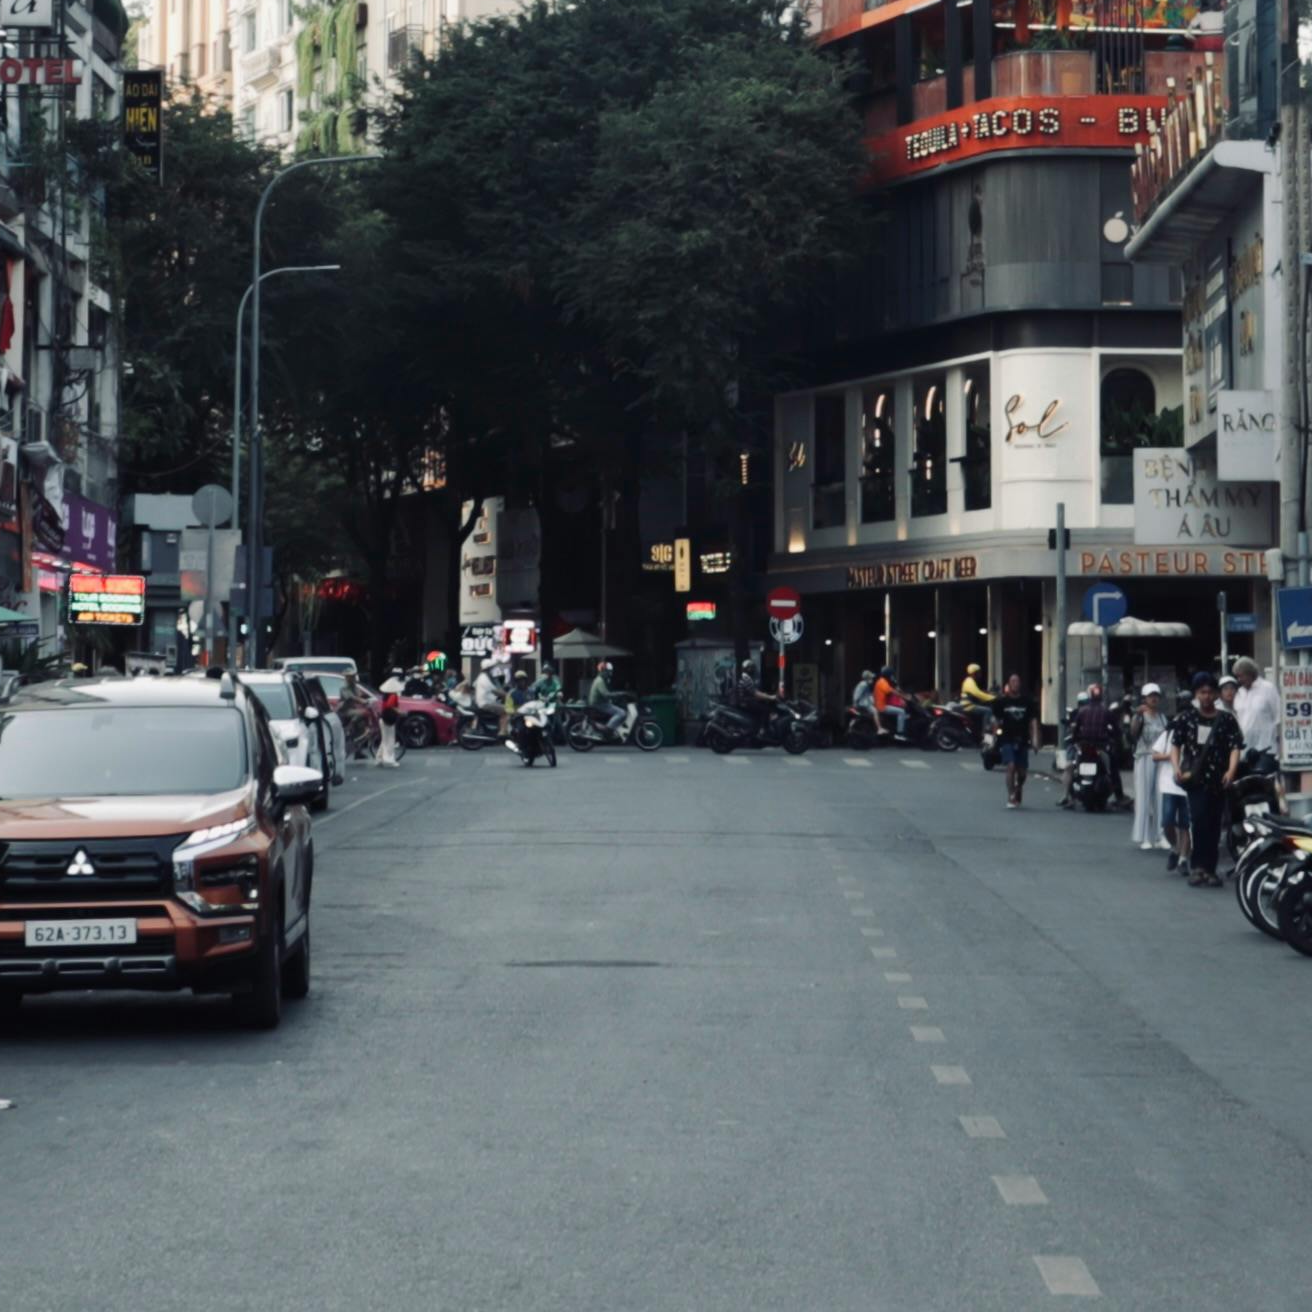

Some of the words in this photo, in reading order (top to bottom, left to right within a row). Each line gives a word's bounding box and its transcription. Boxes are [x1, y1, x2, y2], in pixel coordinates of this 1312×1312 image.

[972, 107, 1060, 140] TACOS
[888, 559, 919, 585] STREET
[923, 557, 952, 581] CRAFT
[954, 555, 977, 579] BEER
[1081, 551, 1208, 576] PASTEUR
[34, 924, 127, 943] 62A-373.13
